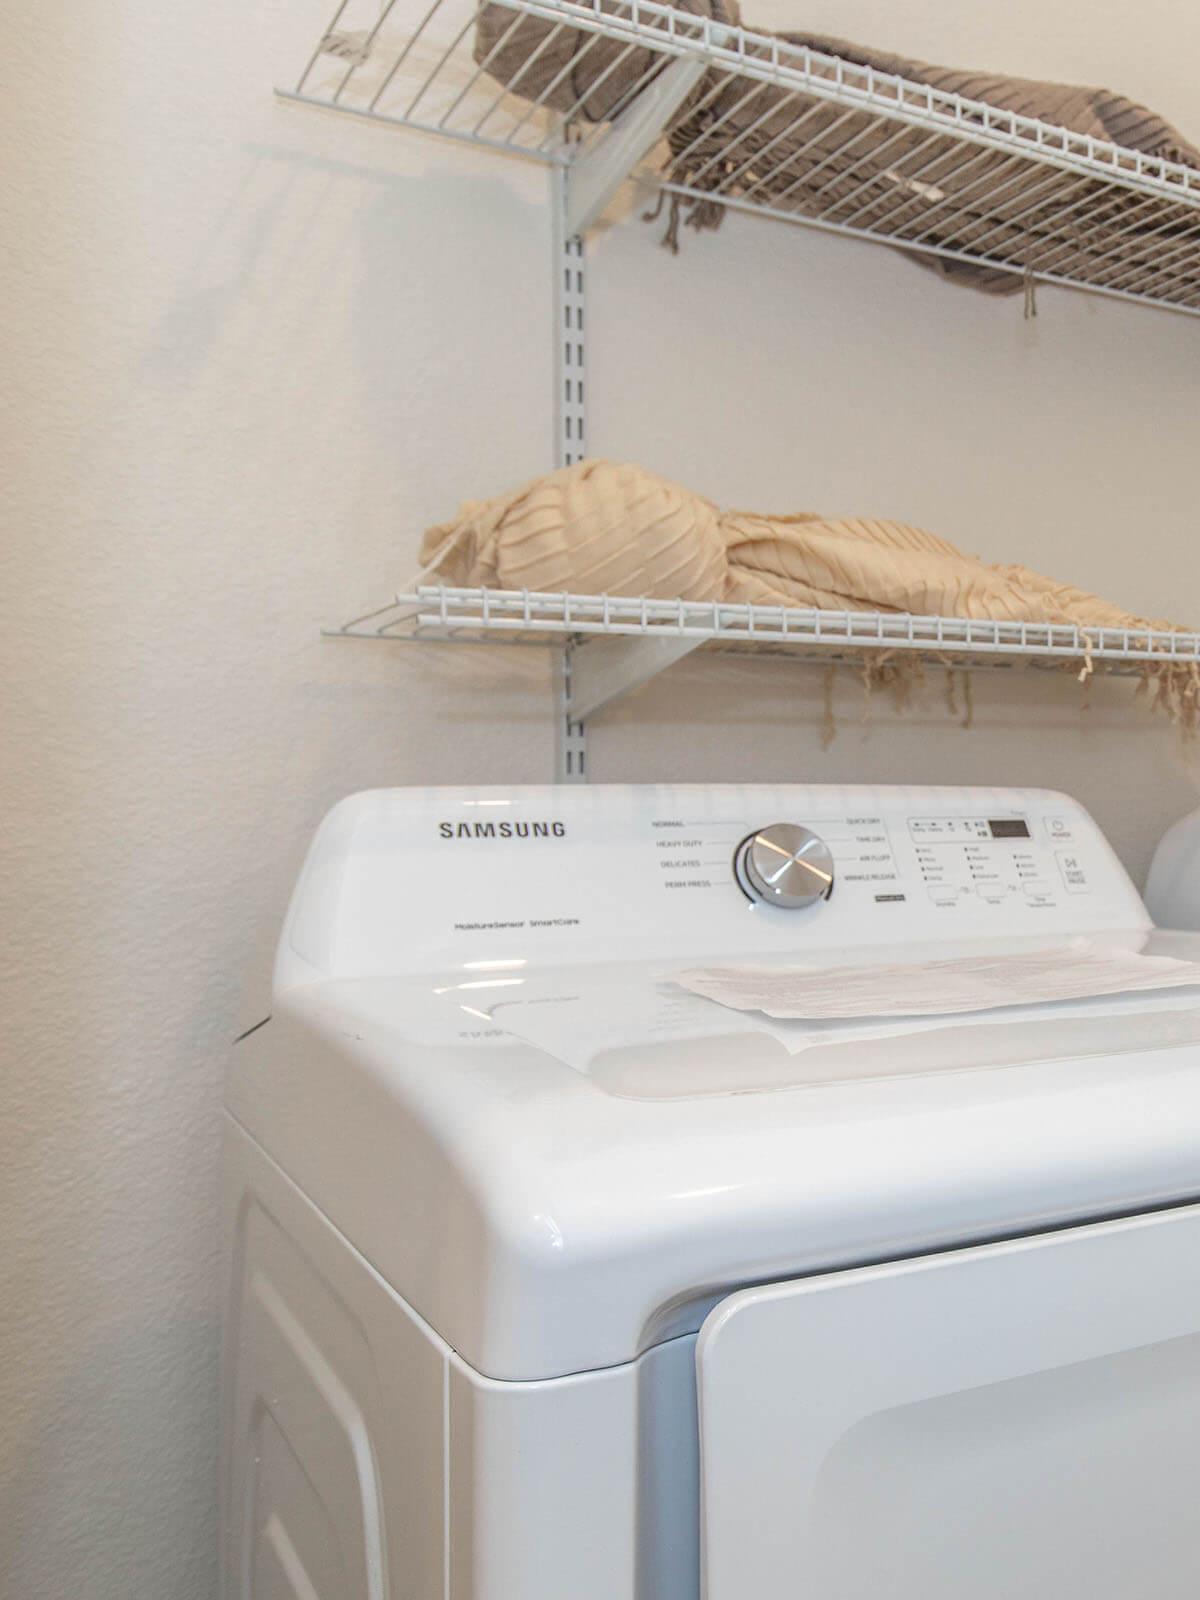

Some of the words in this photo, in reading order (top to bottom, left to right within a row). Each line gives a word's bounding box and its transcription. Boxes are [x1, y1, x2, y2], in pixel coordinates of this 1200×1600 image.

[439, 822, 566, 839] SAMSUNG
[656, 839, 682, 848] HEAVY
[683, 839, 703, 847] DUTY
[660, 859, 701, 868] DELICATES
[665, 880, 687, 888] PERM
[687, 880, 712, 888] PRESS
[454, 920, 525, 931] MoistureSensor
[529, 918, 580, 928] SmartCare
